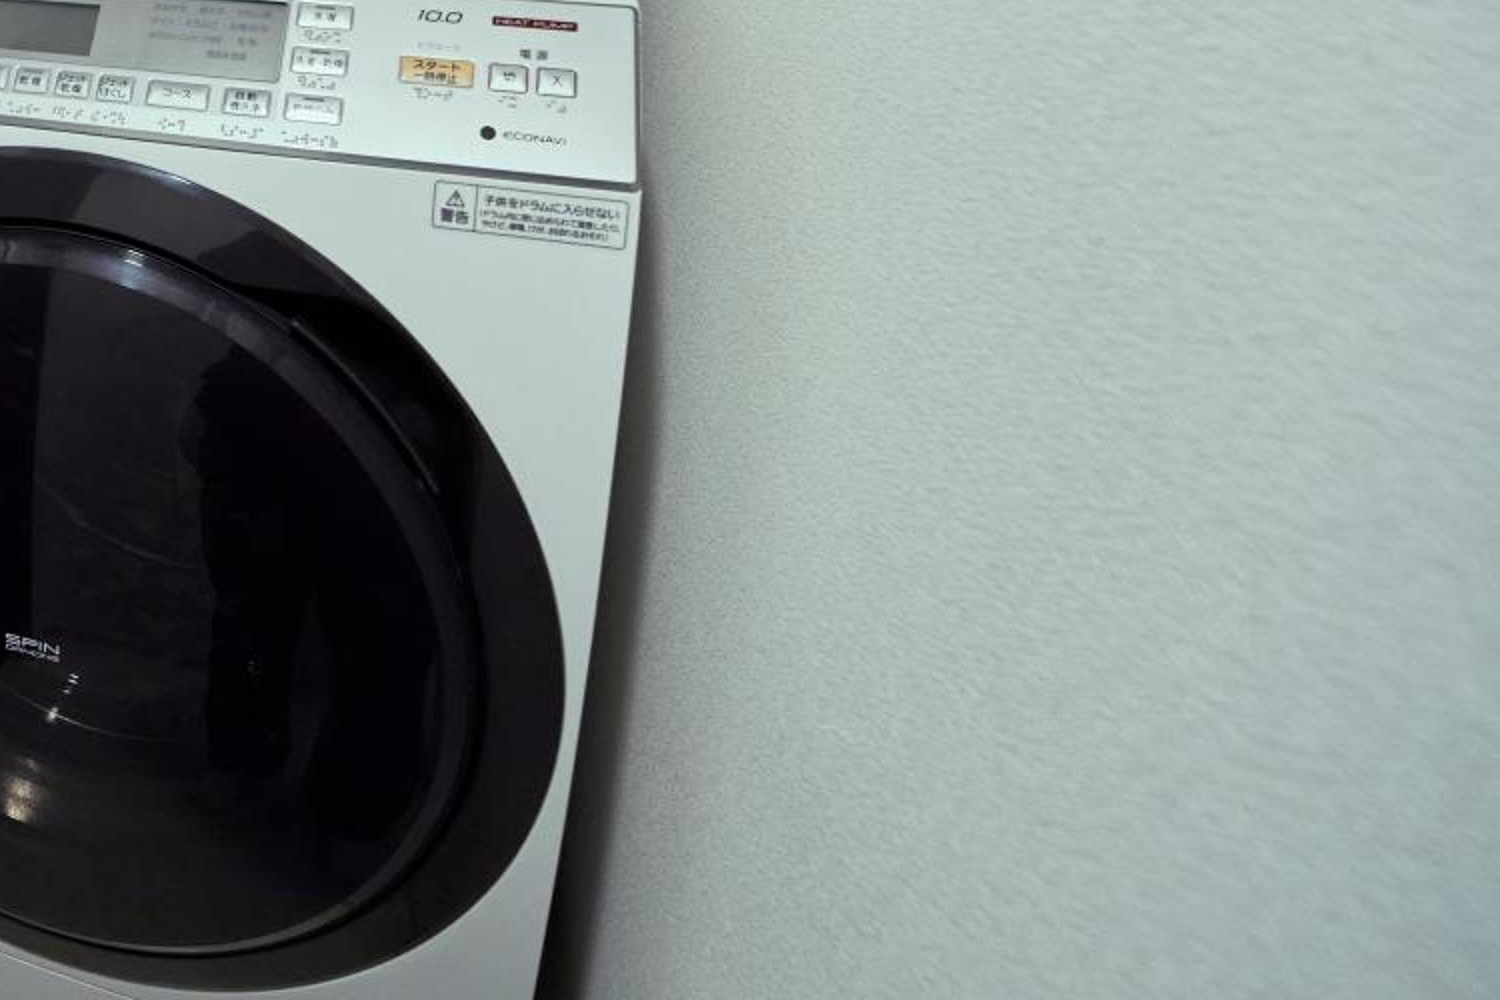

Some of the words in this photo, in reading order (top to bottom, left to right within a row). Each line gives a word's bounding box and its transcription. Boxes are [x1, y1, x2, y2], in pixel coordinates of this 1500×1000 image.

[417, 9, 464, 24] 10.0
[412, 59, 461, 72] スタート
[163, 86, 195, 100] コース
[440, 207, 469, 225] 警告
[4, 632, 61, 656] SPIN
